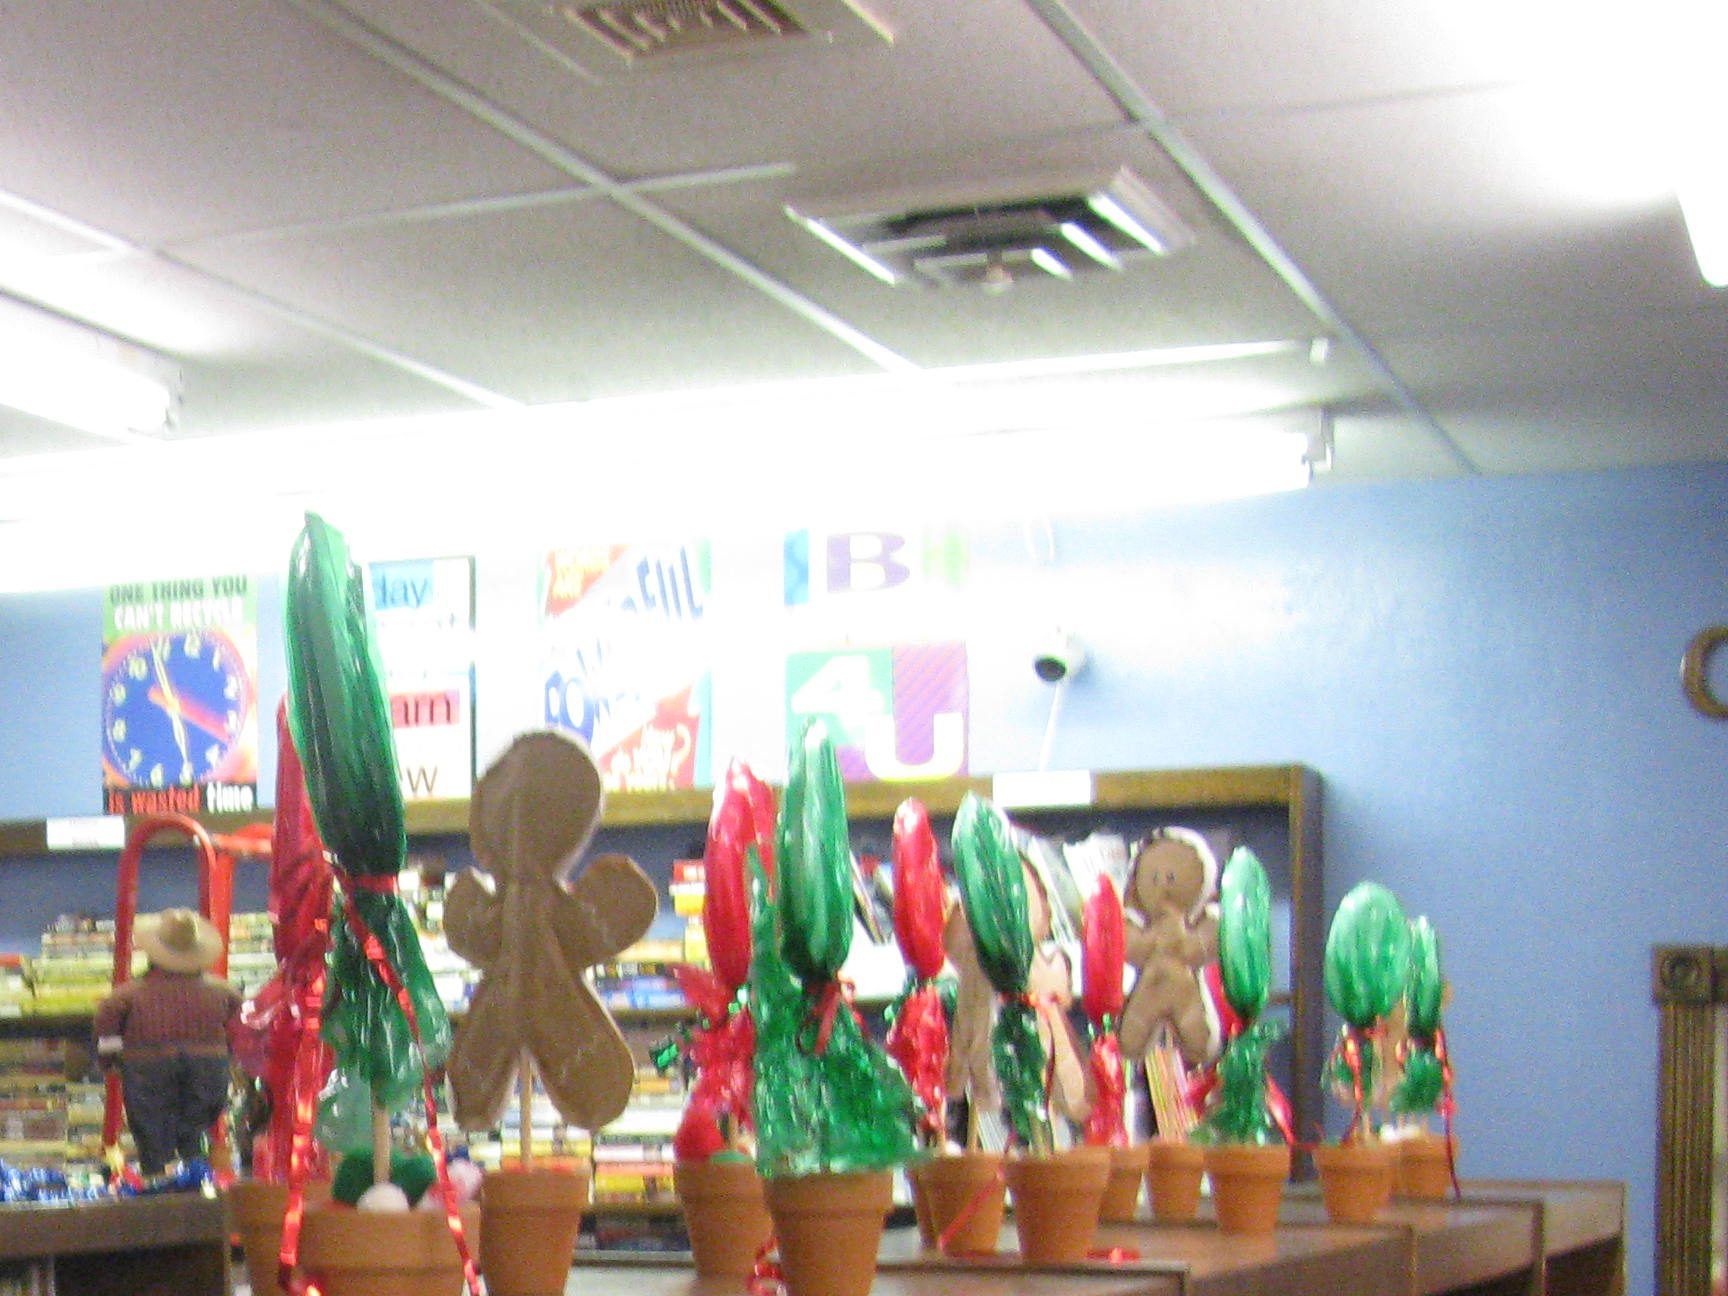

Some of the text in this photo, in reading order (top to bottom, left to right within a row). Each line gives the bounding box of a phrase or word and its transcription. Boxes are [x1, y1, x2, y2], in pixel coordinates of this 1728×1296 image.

[109, 573, 248, 605] ONE THING YOU
[113, 603, 165, 630] CAN'T
[109, 780, 254, 816] is wasted time
